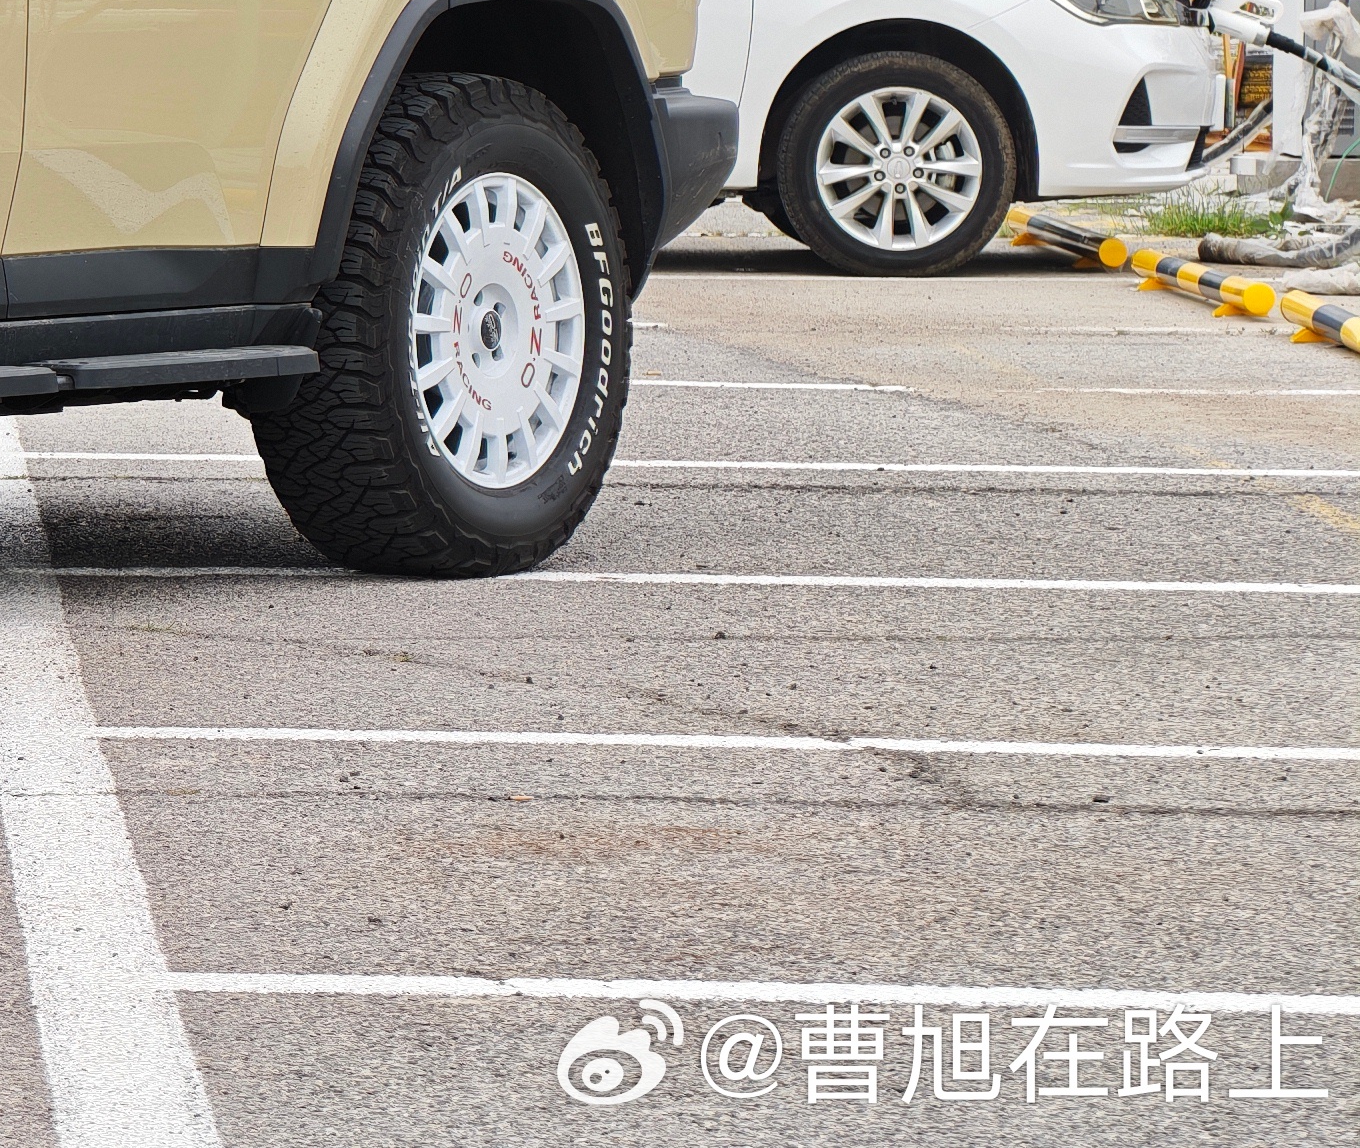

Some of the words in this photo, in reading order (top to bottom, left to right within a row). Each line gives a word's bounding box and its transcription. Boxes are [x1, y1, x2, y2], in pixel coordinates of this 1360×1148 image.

[502, 249, 543, 320] RACING
[453, 340, 493, 412] RACING
[566, 221, 615, 478] BFGoodrich
